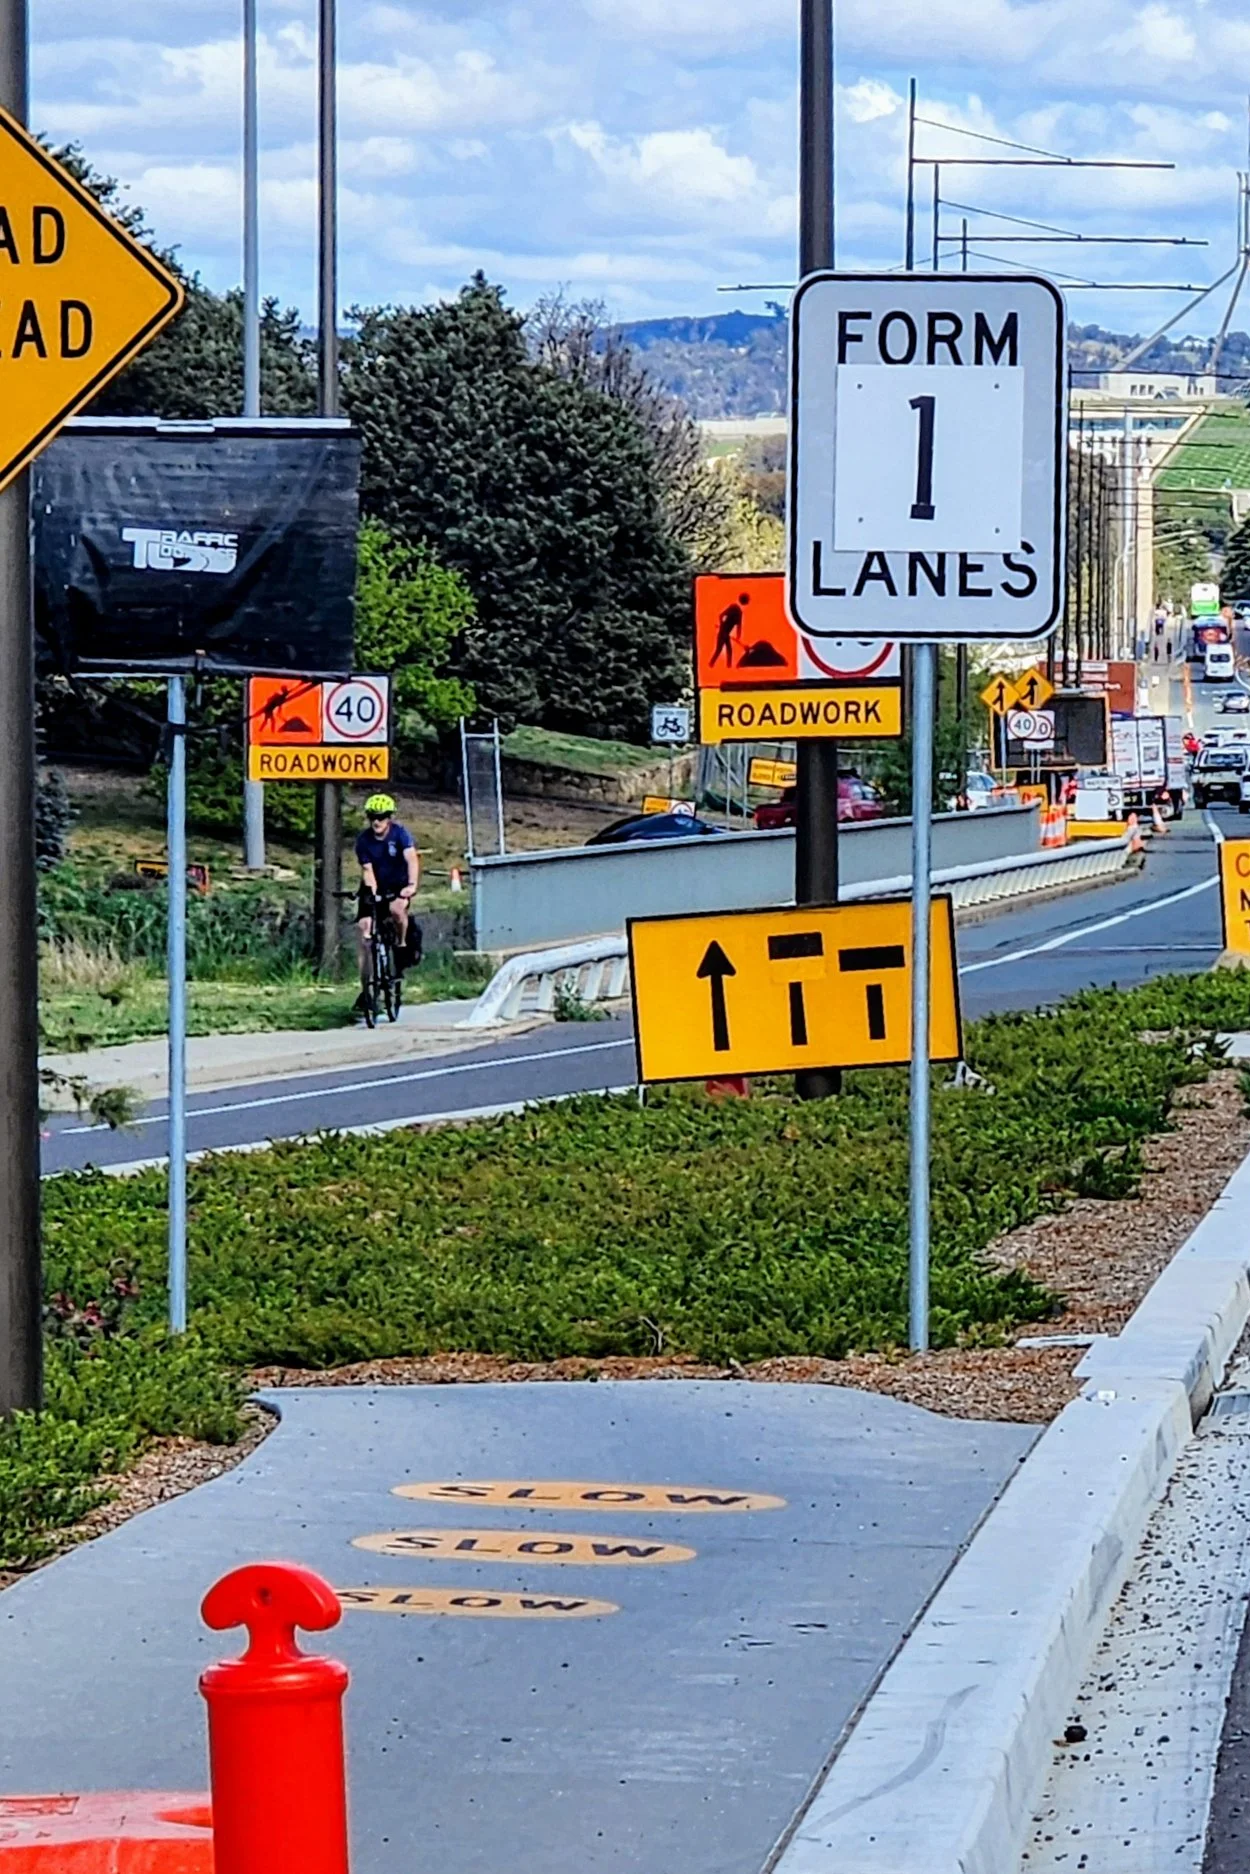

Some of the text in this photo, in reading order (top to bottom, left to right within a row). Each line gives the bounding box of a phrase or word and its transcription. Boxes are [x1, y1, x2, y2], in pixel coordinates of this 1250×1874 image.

[0, 300, 93, 358] AD
[837, 310, 1018, 366] FORM
[908, 395, 936, 521] 1
[812, 540, 1038, 598] LANES
[335, 696, 375, 722] 40
[718, 700, 881, 727] ROADWORK
[1014, 719, 1031, 730] 40
[260, 754, 382, 772] ROADWORK
[428, 1485, 749, 1505] SLOW
[385, 1536, 665, 1558] SLOW
[334, 1591, 588, 1610] SLOW
